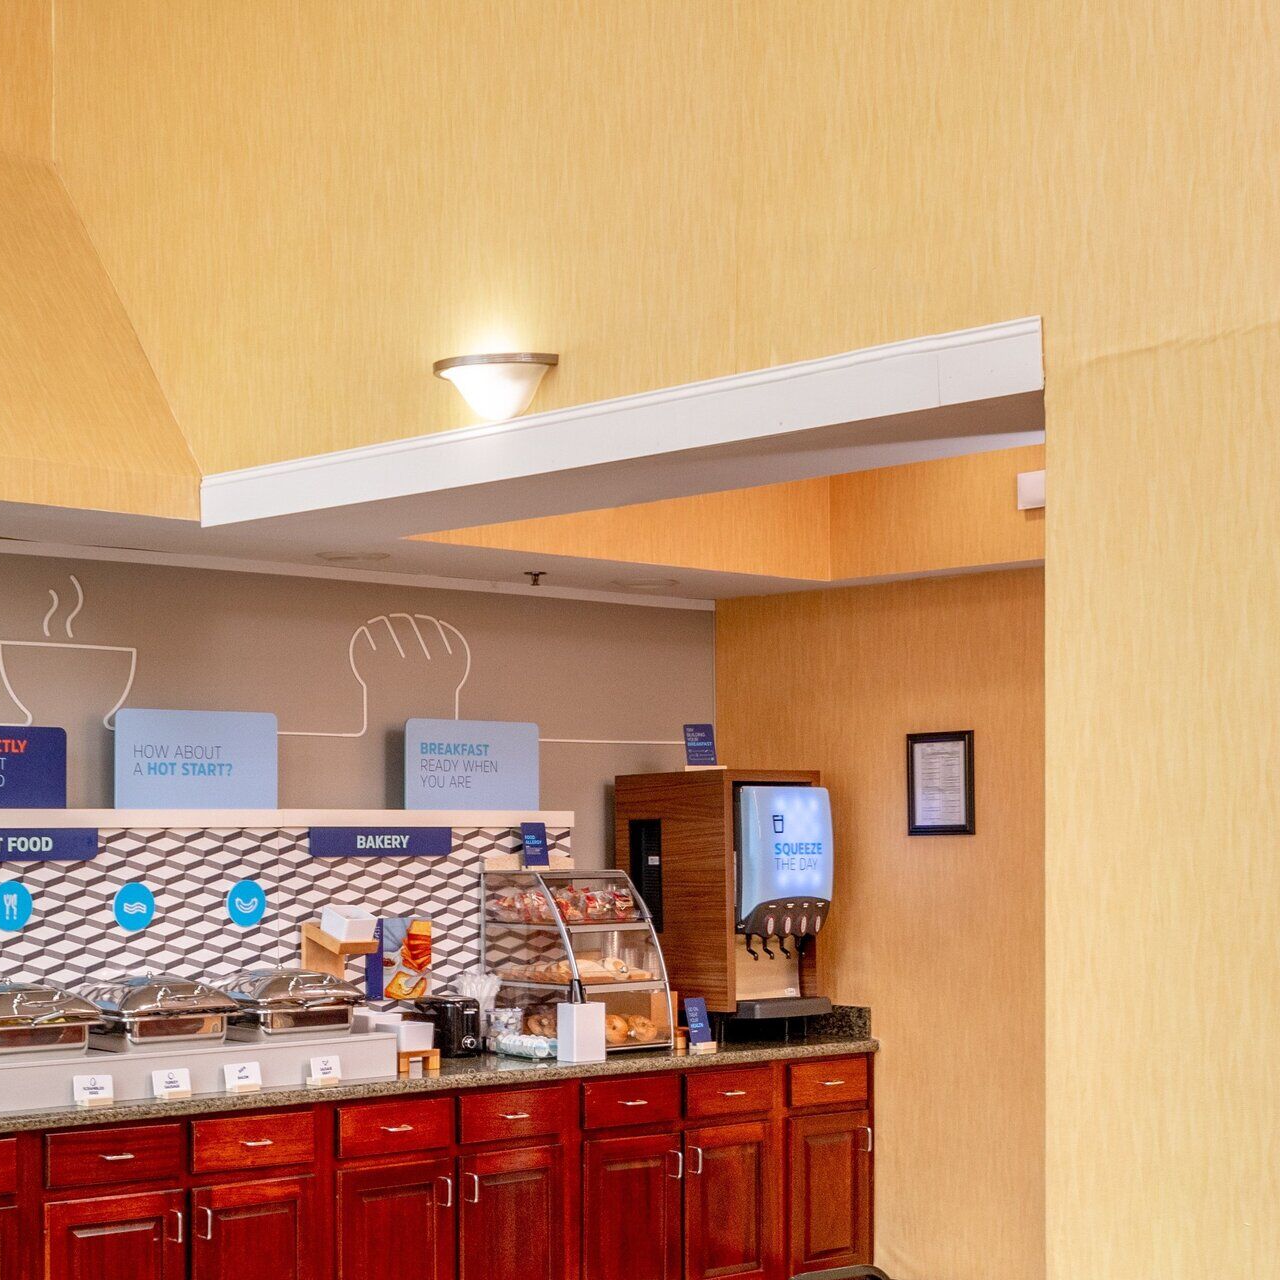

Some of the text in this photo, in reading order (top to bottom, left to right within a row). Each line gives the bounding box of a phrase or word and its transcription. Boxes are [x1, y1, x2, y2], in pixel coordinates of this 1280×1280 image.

[133, 744, 221, 760] HOW ABOUT
[420, 742, 489, 756] BREAKFAST
[133, 762, 233, 777] A HOT START?
[420, 759, 498, 773] READY WHEN
[420, 775, 472, 789] YOU ARE
[7, 836, 53, 852] FOOD
[356, 835, 410, 849] BAKERY
[774, 842, 823, 856] SQUEEZE
[774, 857, 818, 871] THE DAY
